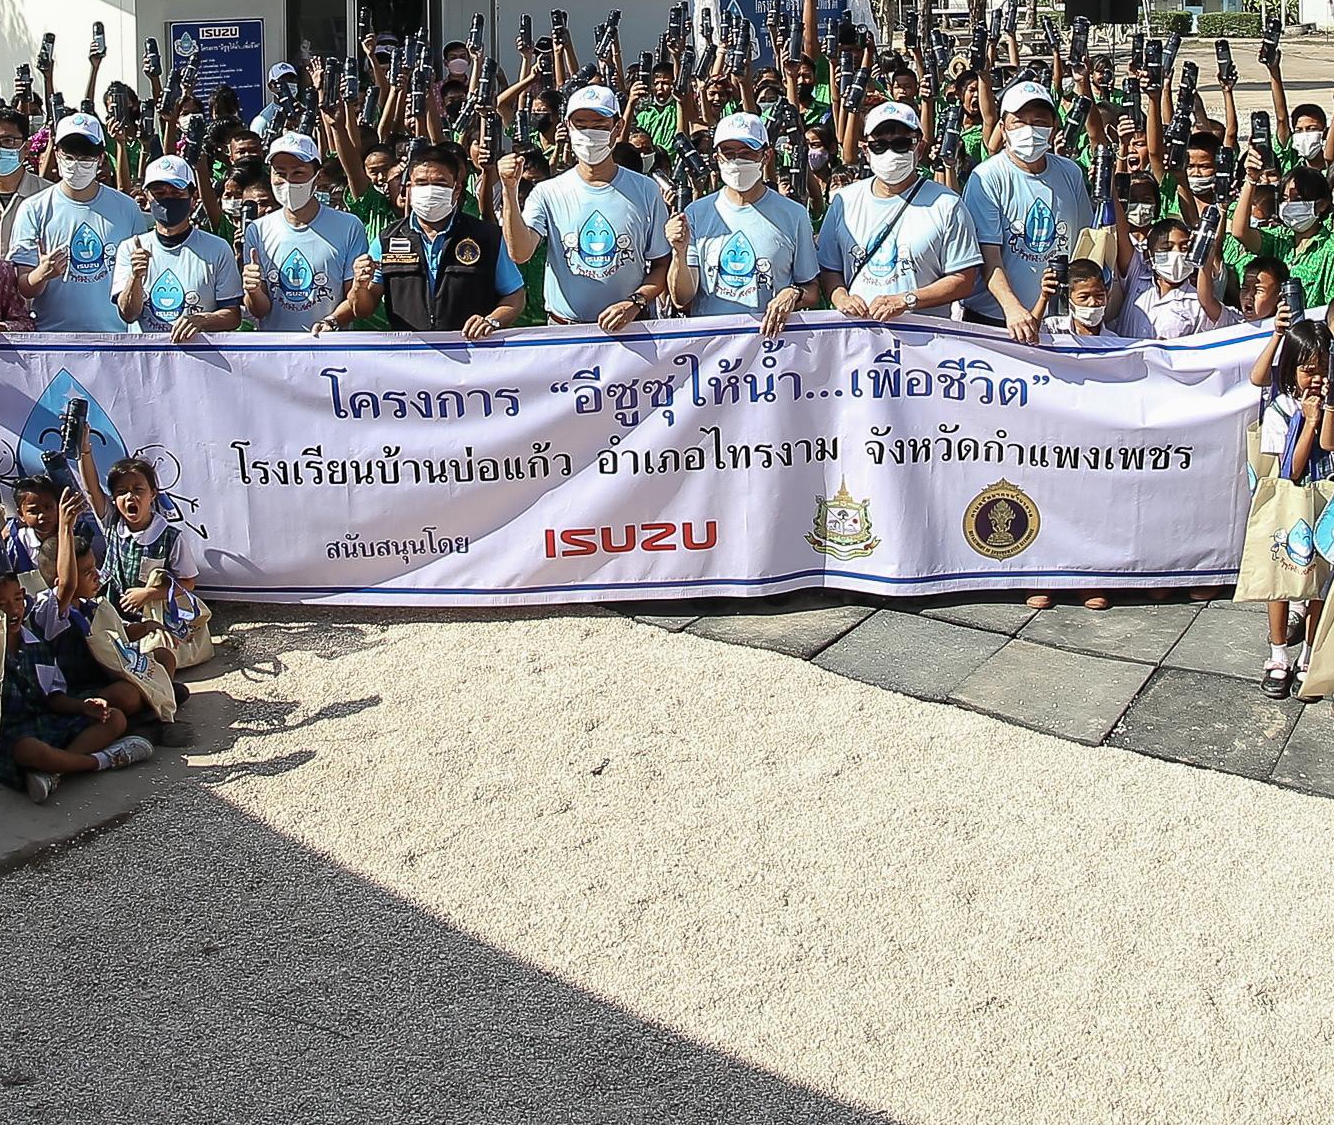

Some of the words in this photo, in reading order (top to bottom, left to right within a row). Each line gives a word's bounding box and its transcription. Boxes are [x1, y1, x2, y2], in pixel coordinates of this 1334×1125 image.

[201, 27, 238, 38] ISUZU
[321, 367, 520, 420] โครงการ
[231, 438, 573, 488] โรงเรียนบ้านบ่อแก้ว
[598, 426, 839, 476] อำเภอไทรงาม
[865, 423, 1193, 472] จังหวัดกำแพงเพชร
[325, 526, 470, 566] สนับสนุนโดย
[544, 519, 718, 560] ISUZU
